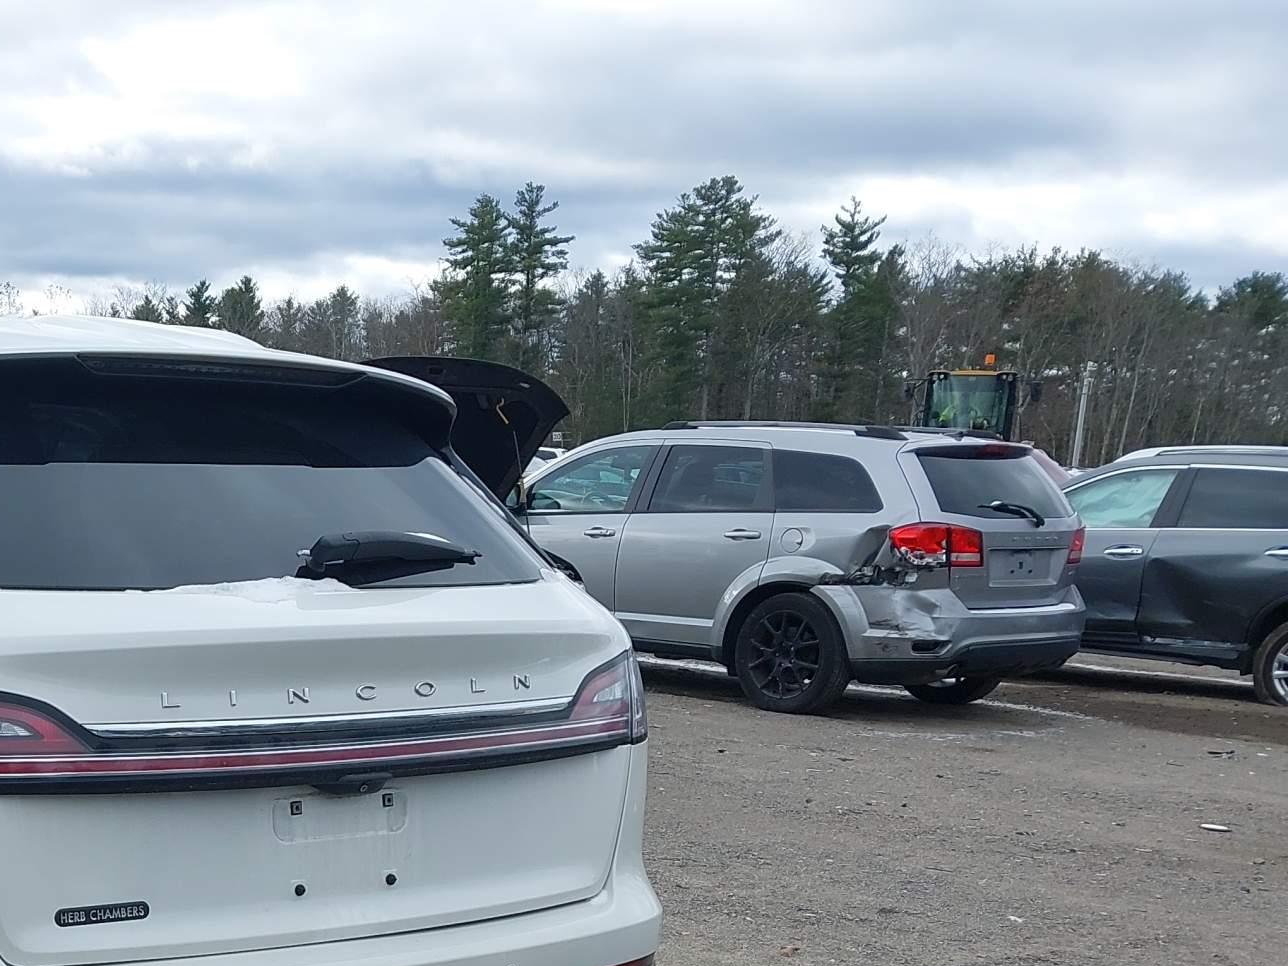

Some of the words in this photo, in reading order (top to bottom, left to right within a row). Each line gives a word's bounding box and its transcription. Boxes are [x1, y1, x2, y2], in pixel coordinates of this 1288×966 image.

[160, 674, 532, 709] LINCOLN
[60, 911, 86, 924] HERB
[90, 905, 145, 921] CHAMBERS
